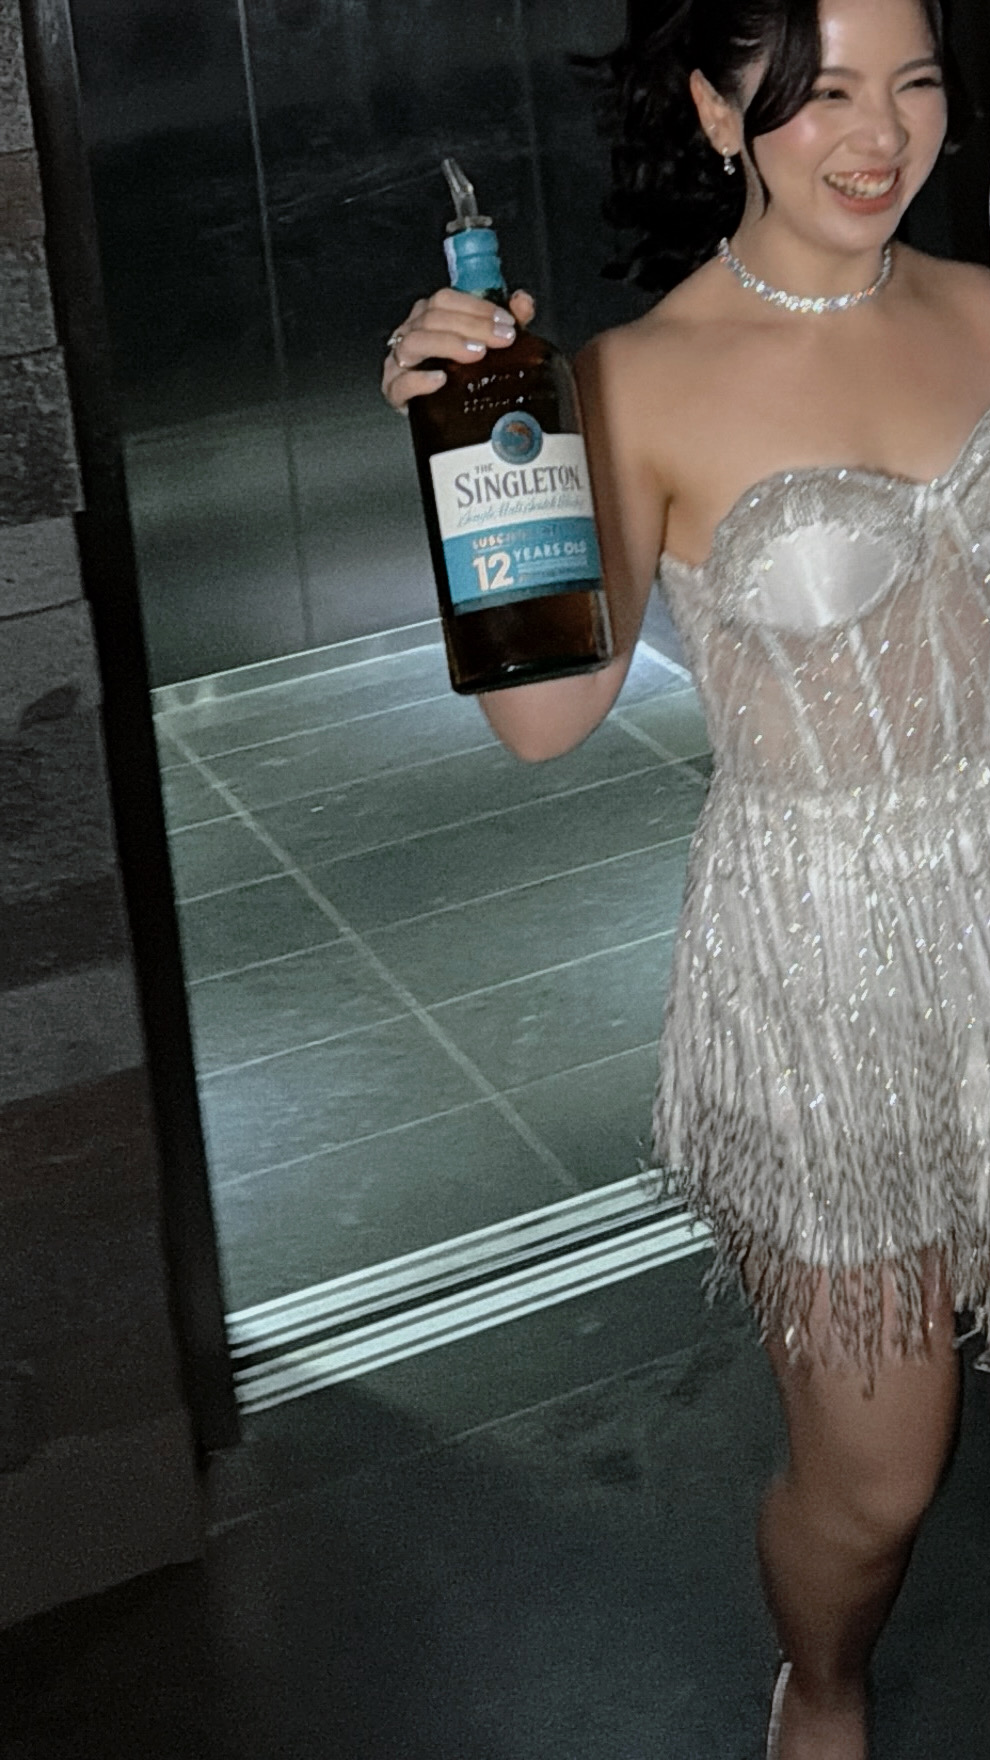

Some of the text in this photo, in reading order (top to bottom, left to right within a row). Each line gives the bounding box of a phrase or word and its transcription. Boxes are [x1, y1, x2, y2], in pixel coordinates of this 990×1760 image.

[454, 465, 584, 509] SINGLETON
[474, 463, 493, 475] THE
[472, 551, 514, 592] 12
[512, 542, 561, 561] YEARS
